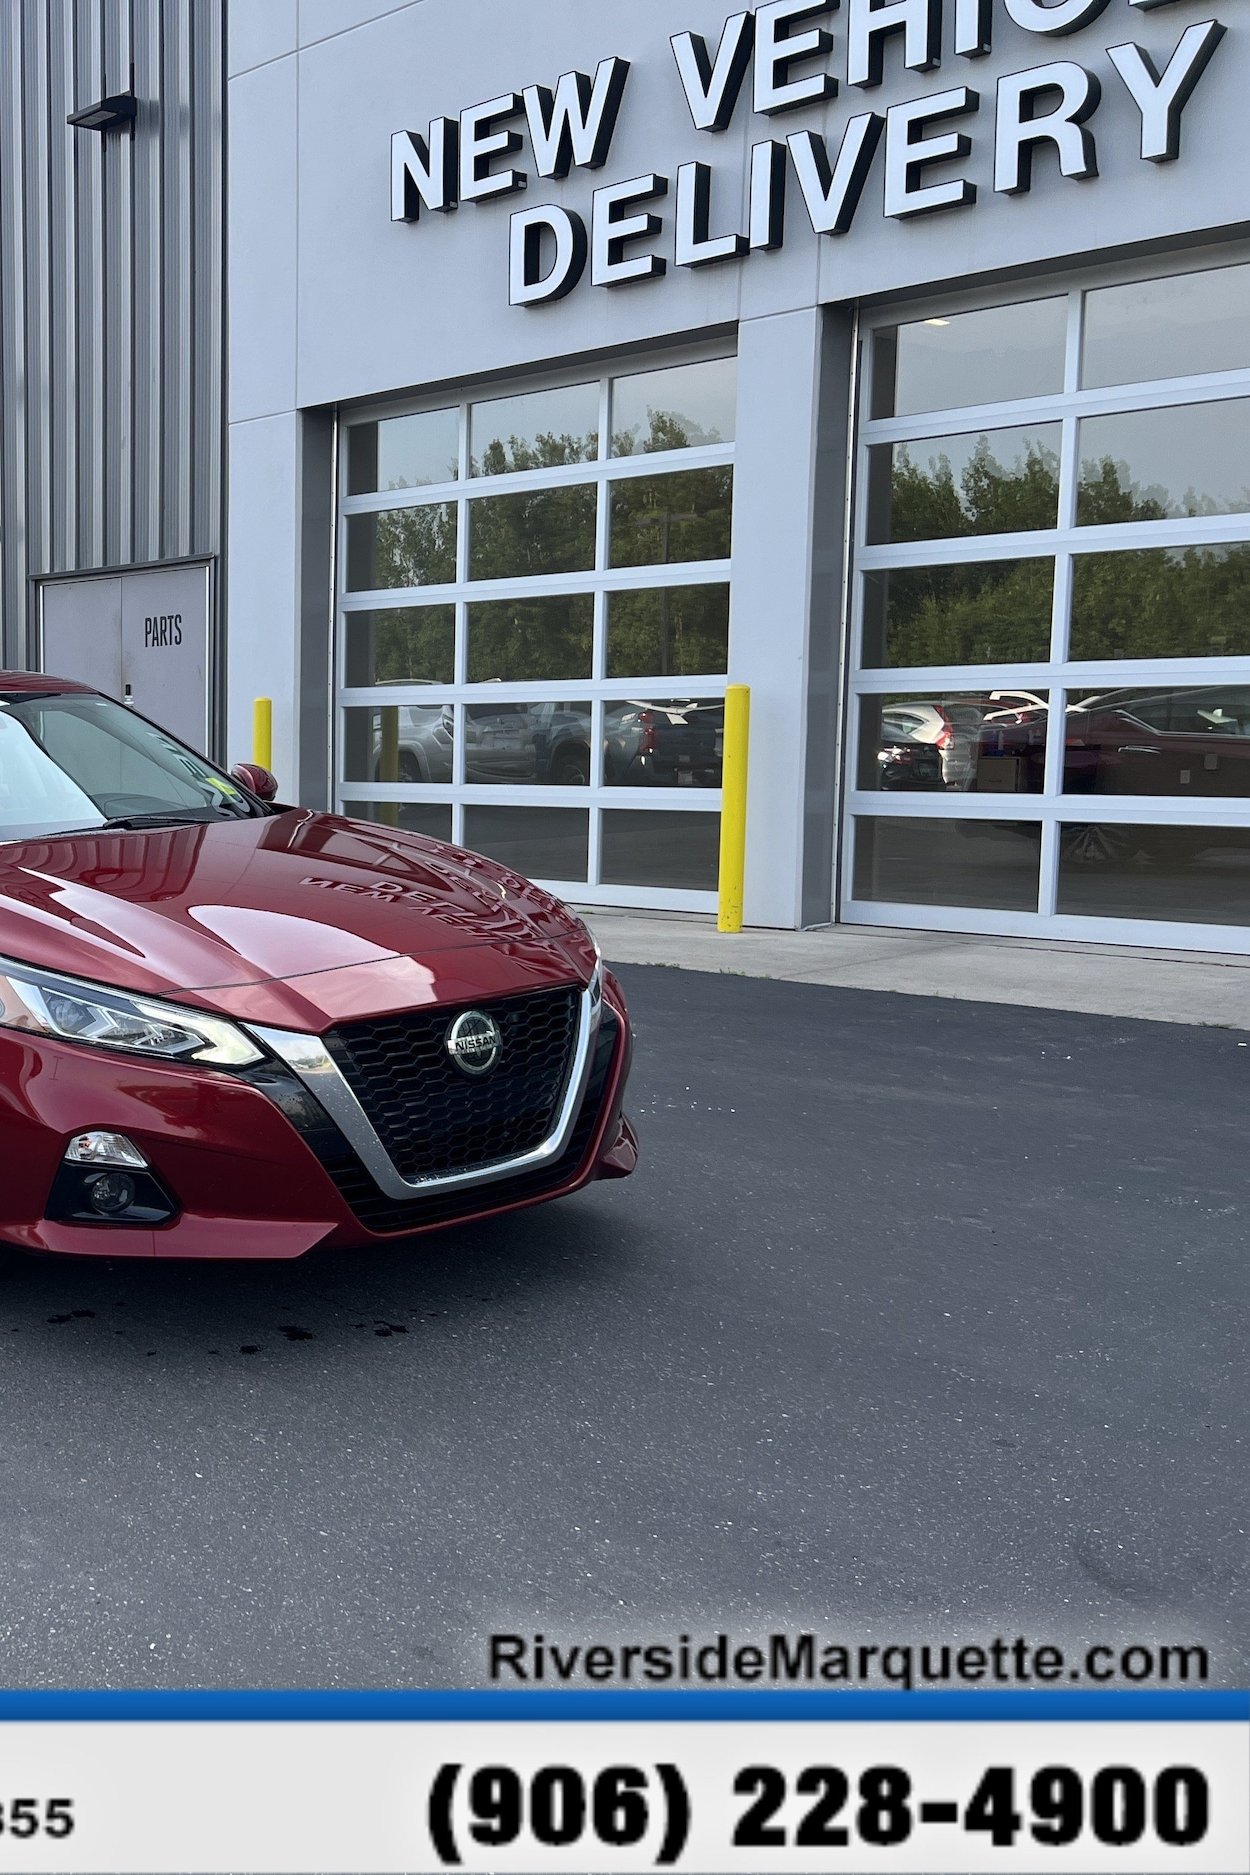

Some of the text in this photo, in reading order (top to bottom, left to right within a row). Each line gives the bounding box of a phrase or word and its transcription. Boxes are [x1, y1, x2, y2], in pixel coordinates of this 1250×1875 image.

[391, 57, 629, 223] NEW
[509, 19, 1228, 307] DELIVERY
[144, 614, 182, 648] PARTS
[455, 1035, 497, 1051] NISSAN
